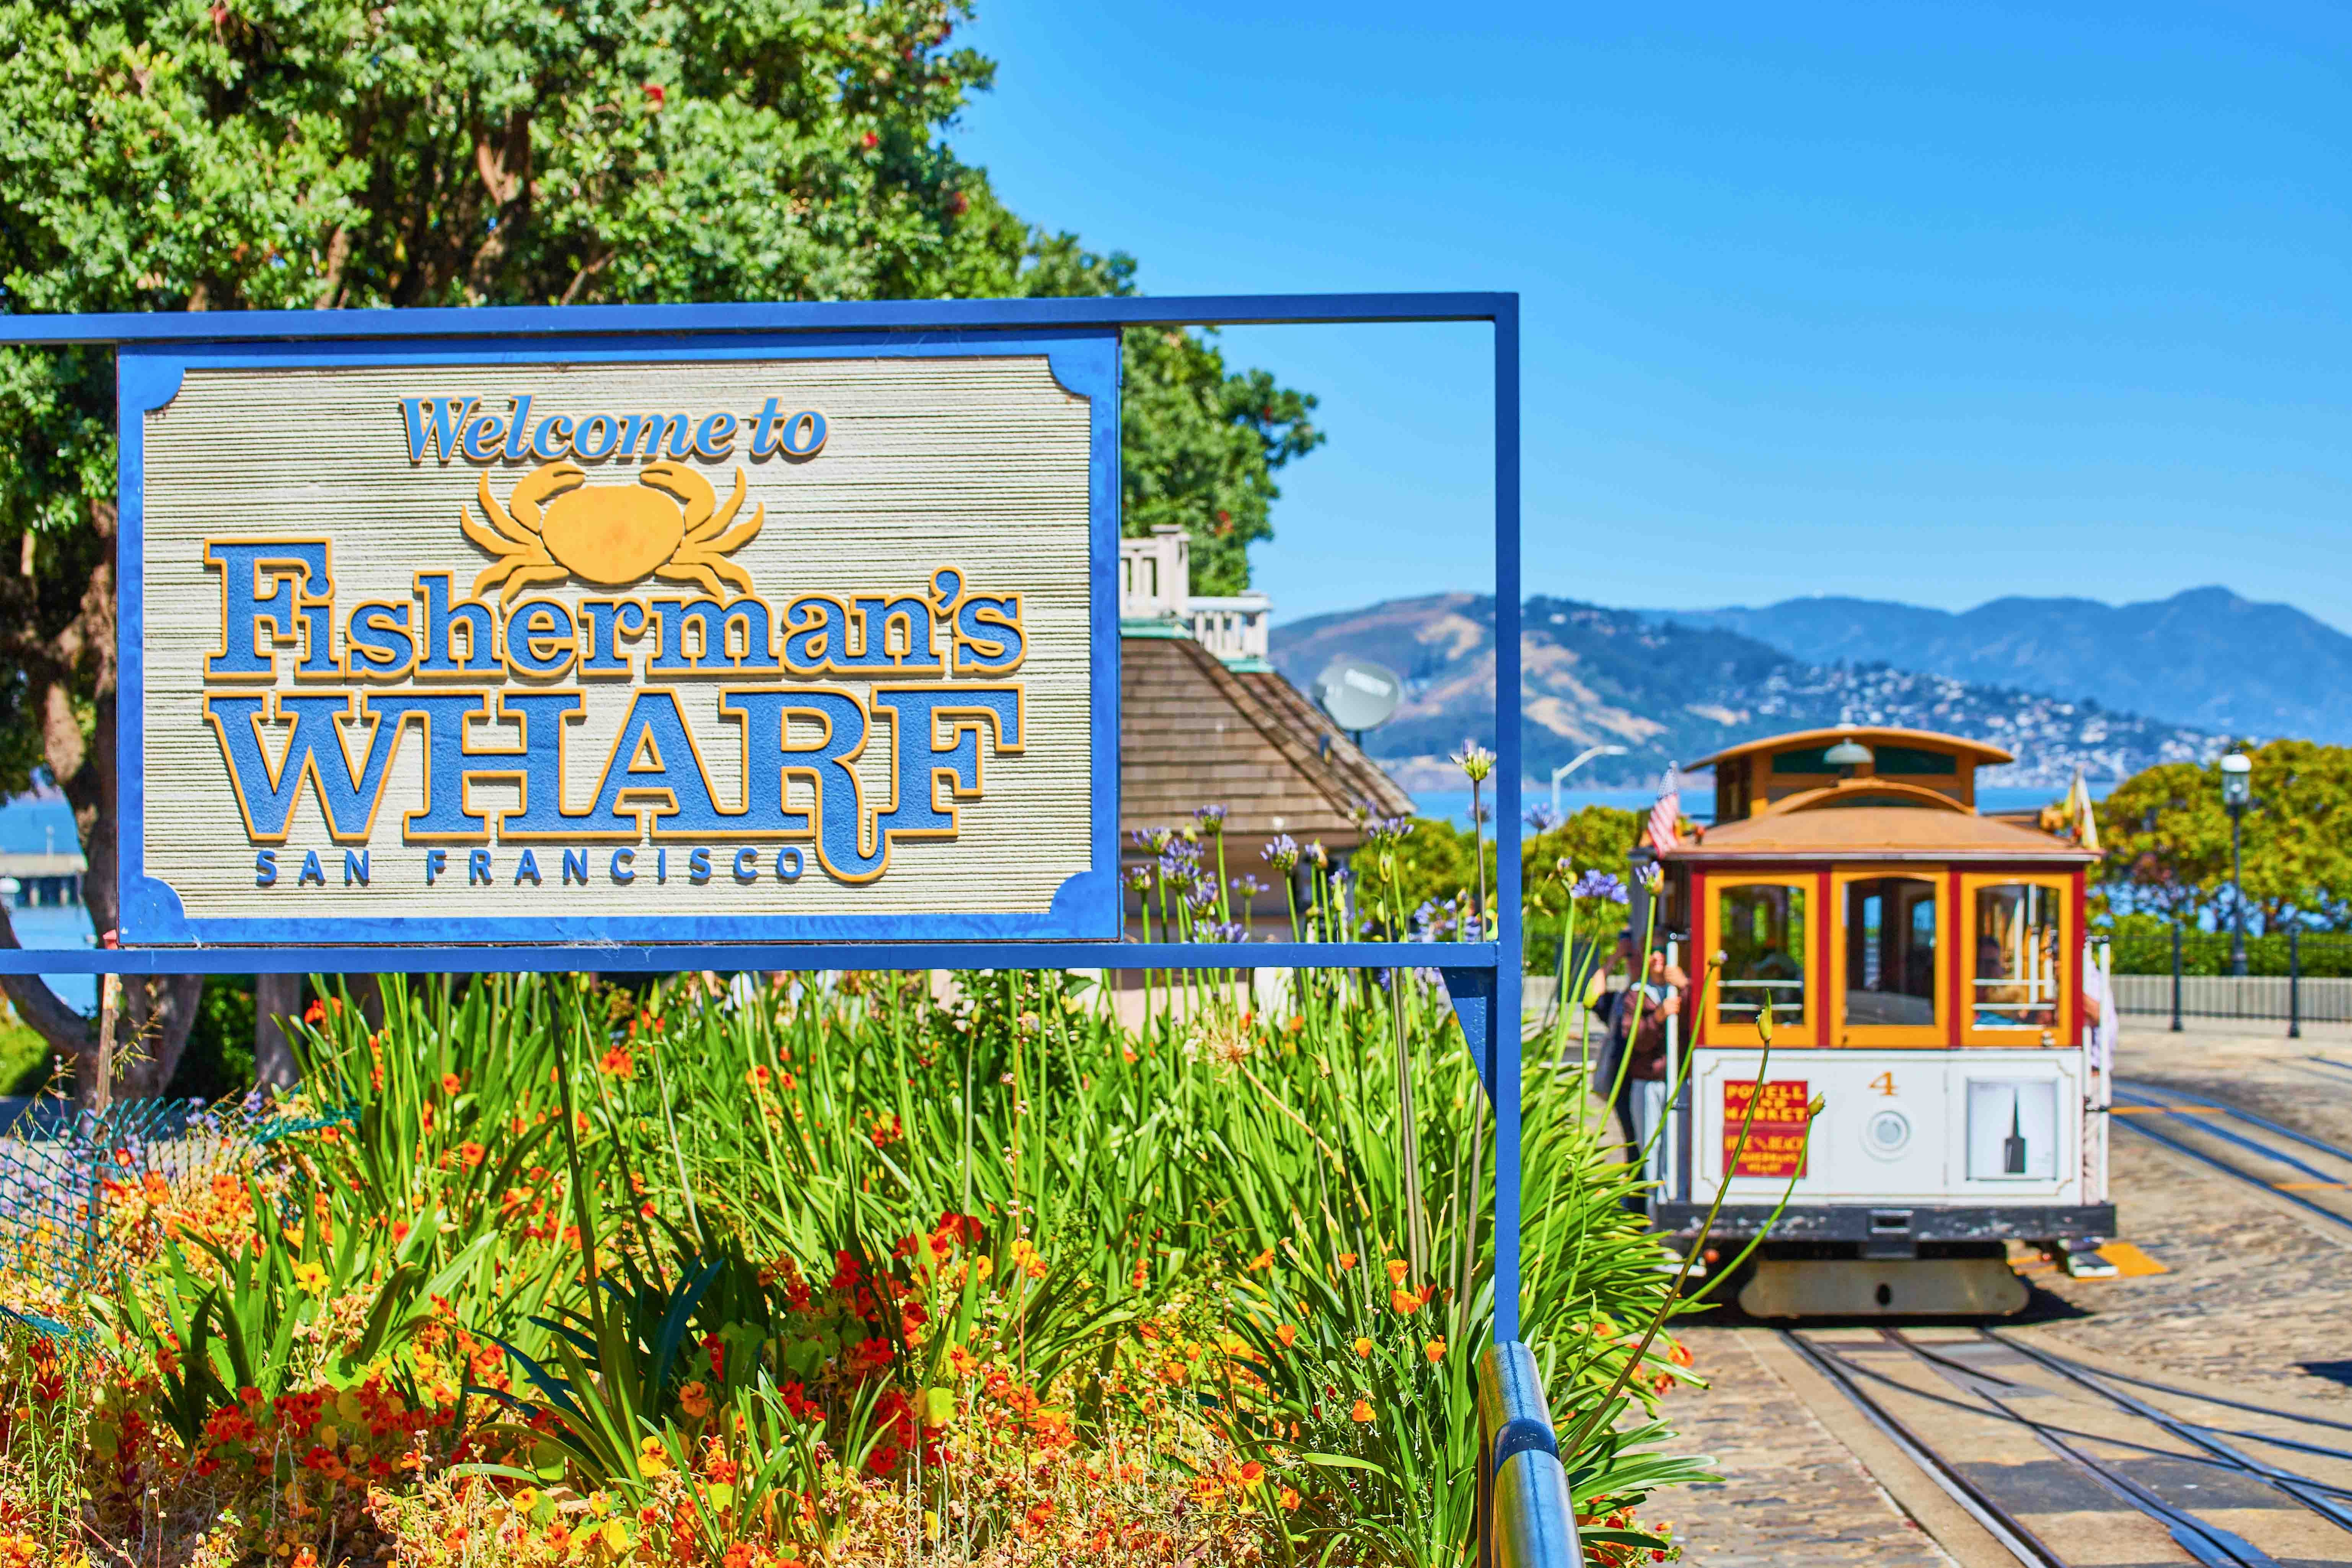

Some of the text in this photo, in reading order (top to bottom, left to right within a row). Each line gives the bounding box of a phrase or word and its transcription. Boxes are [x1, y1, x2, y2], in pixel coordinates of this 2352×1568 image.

[399, 394, 828, 462] Welcome to
[204, 538, 1028, 680] Fisherman's
[202, 683, 1026, 883] WHARF
[256, 847, 805, 885] SAN FRANCISCO
[1868, 1071, 1899, 1096] 4
